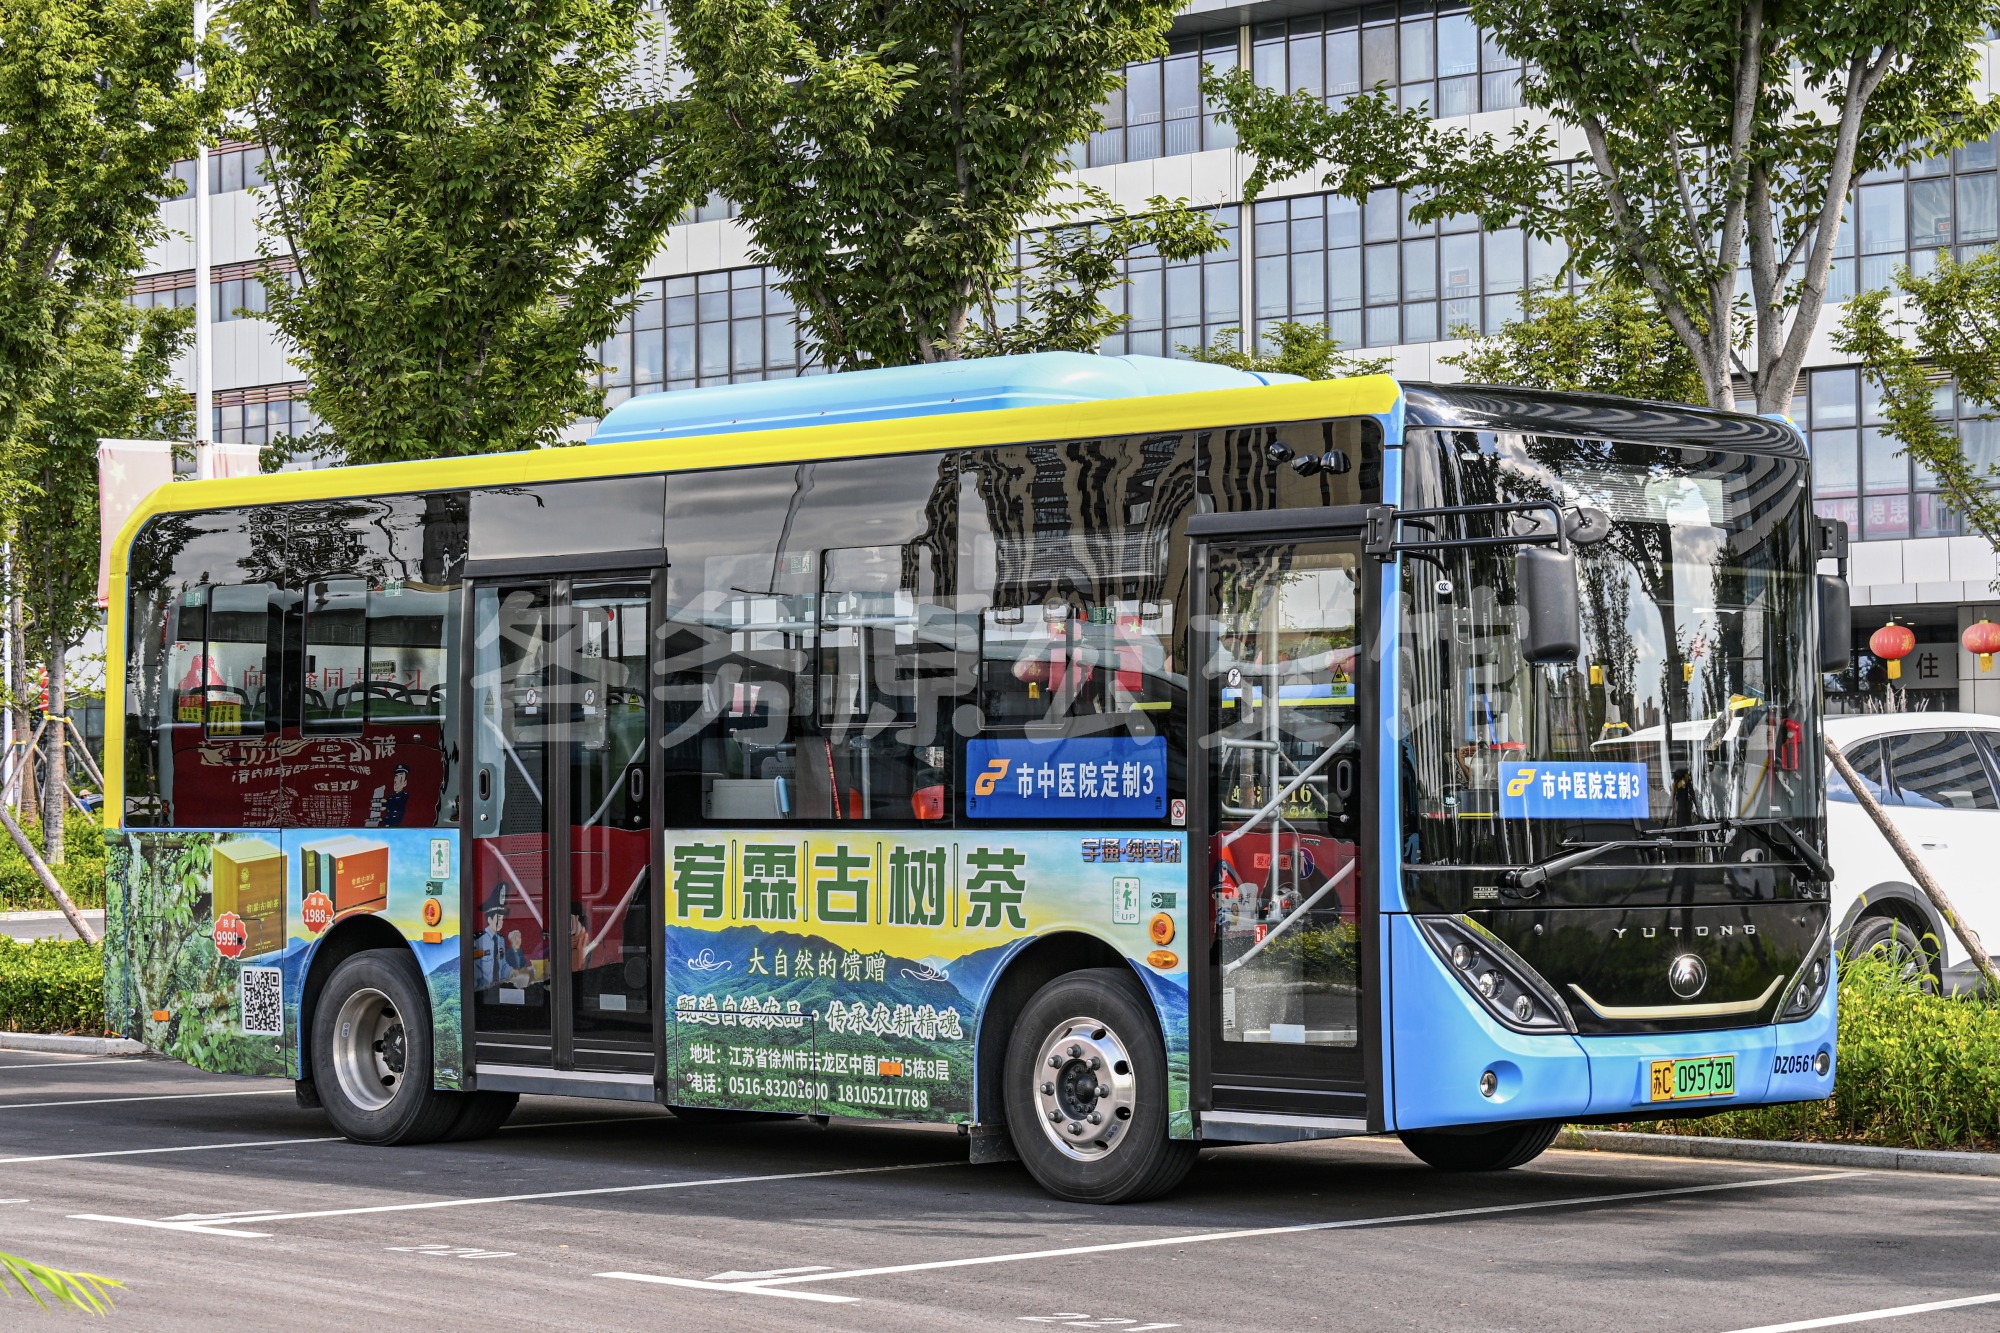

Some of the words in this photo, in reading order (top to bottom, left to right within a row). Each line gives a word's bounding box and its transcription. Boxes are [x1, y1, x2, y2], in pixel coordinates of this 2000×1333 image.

[1016, 761, 1154, 798] 市中医院定制3
[1541, 771, 1640, 800] 市中医院定制3
[1257, 855, 1288, 868] 爱心座
[673, 842, 1027, 930] 宥霖古树茶
[1121, 913, 1136, 921] UP
[1612, 925, 1756, 938] YUTONG
[748, 947, 886, 983] 大自然的馈赠
[1774, 1055, 1815, 1074] DZ0561
[838, 1084, 928, 1108] 18105217788
